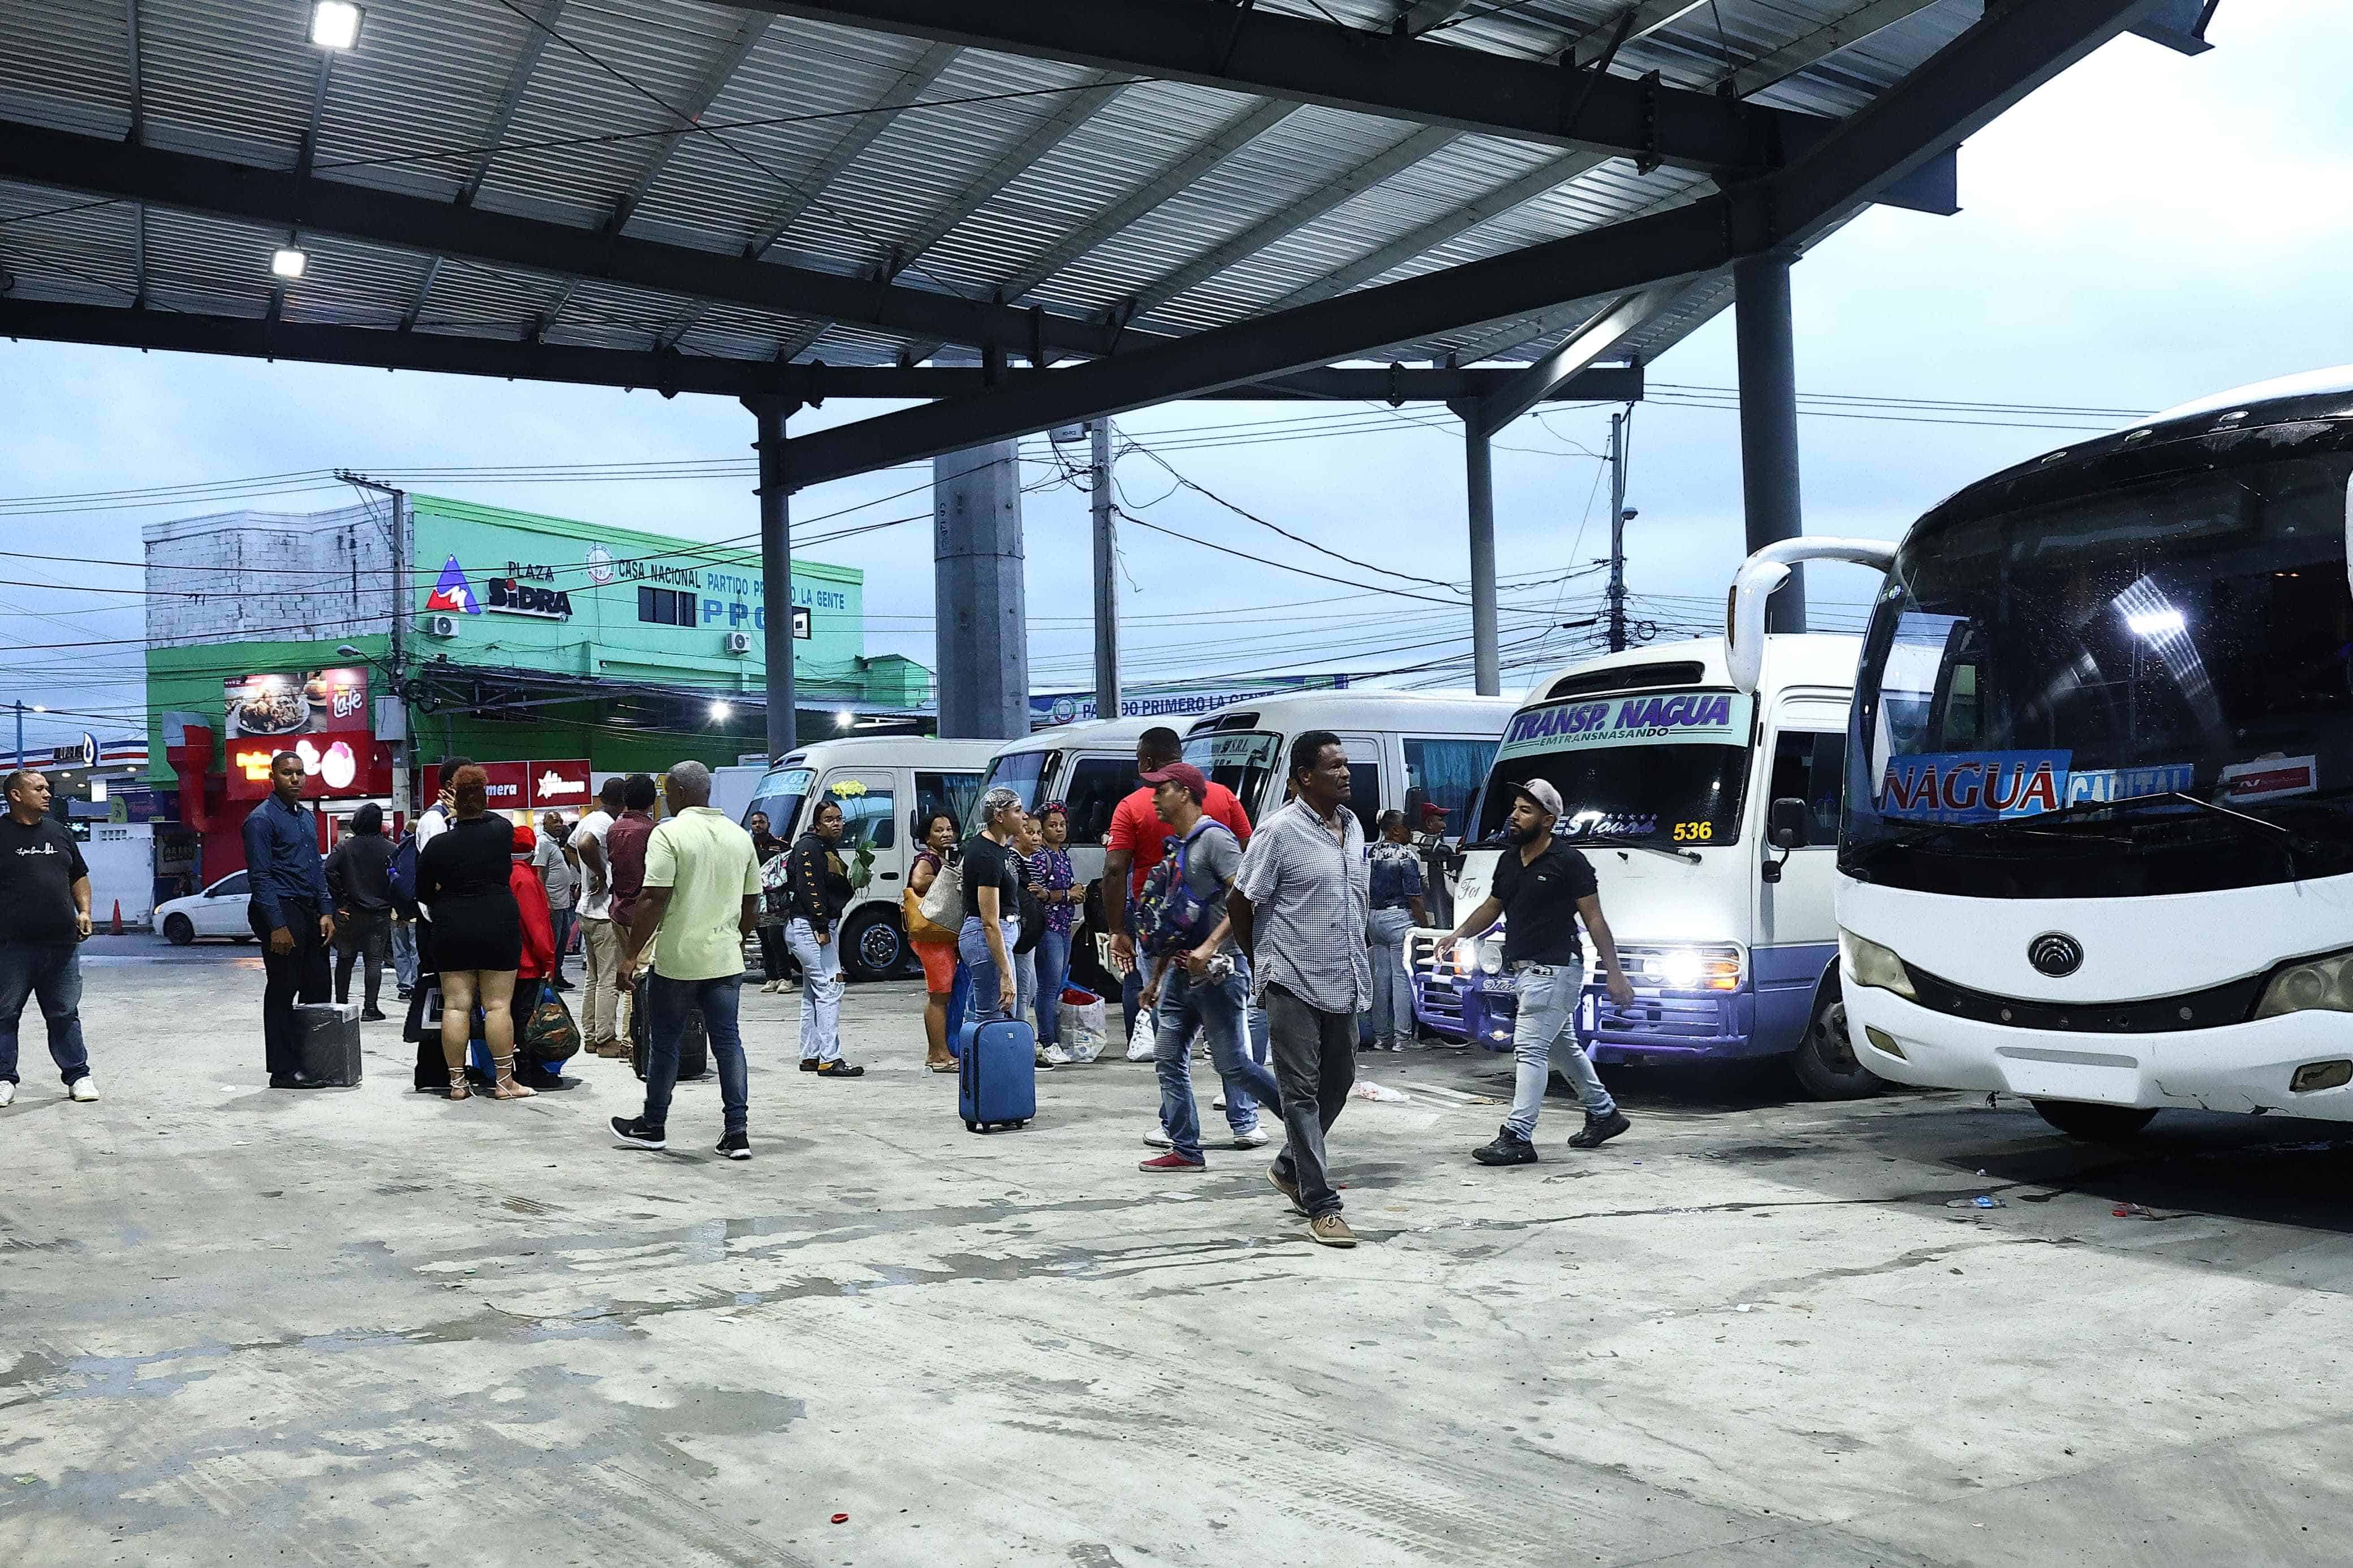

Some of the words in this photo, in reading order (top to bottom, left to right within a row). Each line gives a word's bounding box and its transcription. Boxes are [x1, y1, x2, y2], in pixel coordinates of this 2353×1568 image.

[508, 560, 554, 582] PLAZA
[618, 560, 644, 580] CASA
[651, 564, 701, 589] NACIONAL
[708, 573, 748, 595] PARTIDO
[800, 588, 813, 604] LA
[817, 590, 844, 610] GENTE
[1083, 701, 1138, 719] PADO
[1142, 696, 1205, 715] PRIMERO
[1209, 695, 1225, 711] LA
[1507, 703, 1610, 744] TRANSP.
[1614, 696, 1731, 730] NAGUA
[1539, 727, 1669, 746] EMTRANSNASANDO
[485, 784, 517, 796] mera
[1879, 760, 2060, 813] NAGUA
[1673, 821, 1713, 841] 536
